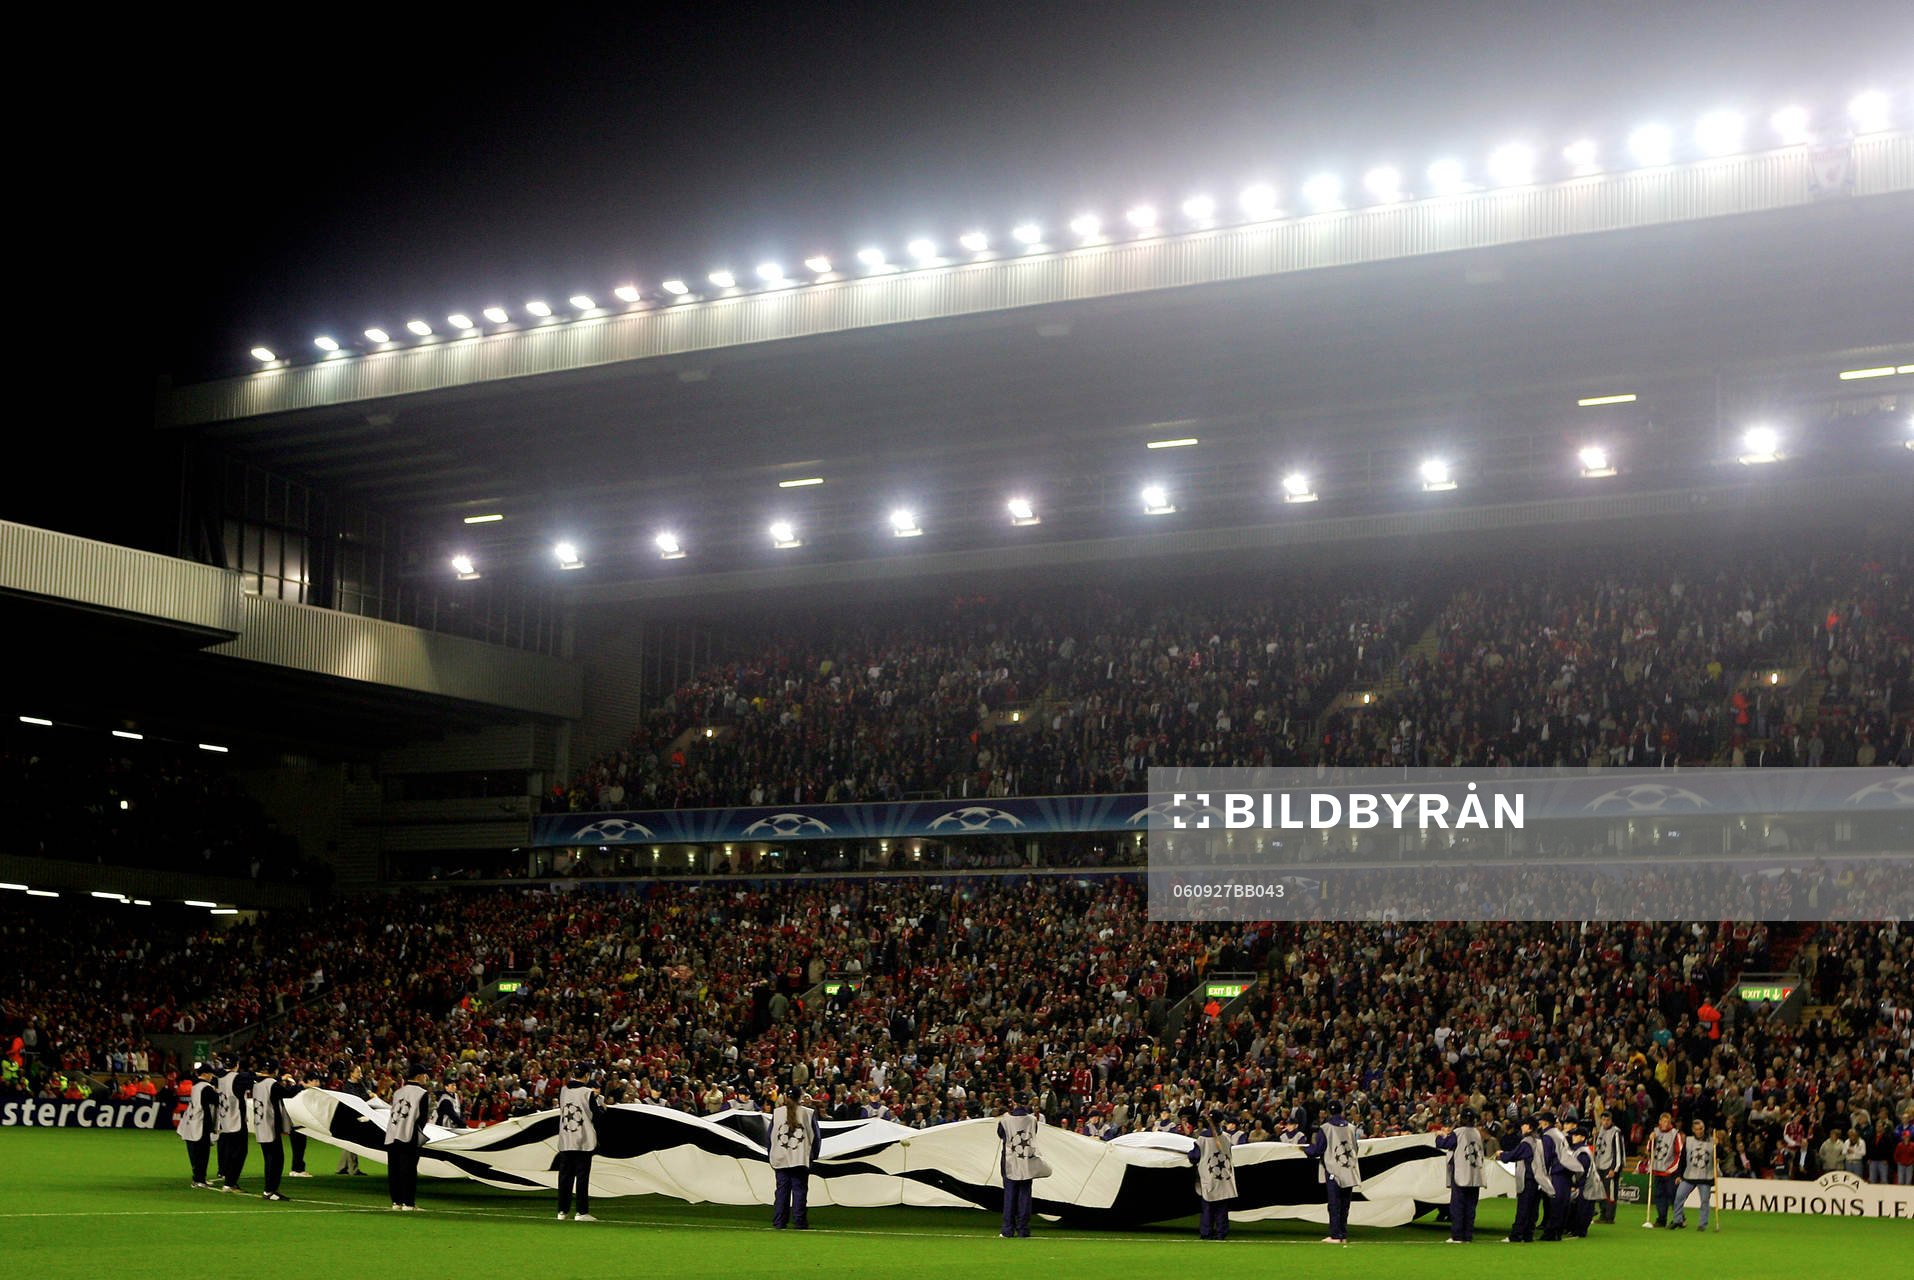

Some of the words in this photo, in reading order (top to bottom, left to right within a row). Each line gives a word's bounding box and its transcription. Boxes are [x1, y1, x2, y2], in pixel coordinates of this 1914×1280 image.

[1208, 987, 1225, 995] EXIT
[1742, 990, 1761, 999] EXIT
[1819, 1174, 1860, 1190] UEFA
[1711, 1192, 1865, 1217] HAMPIONS
[1878, 1200, 1914, 1219] LE
